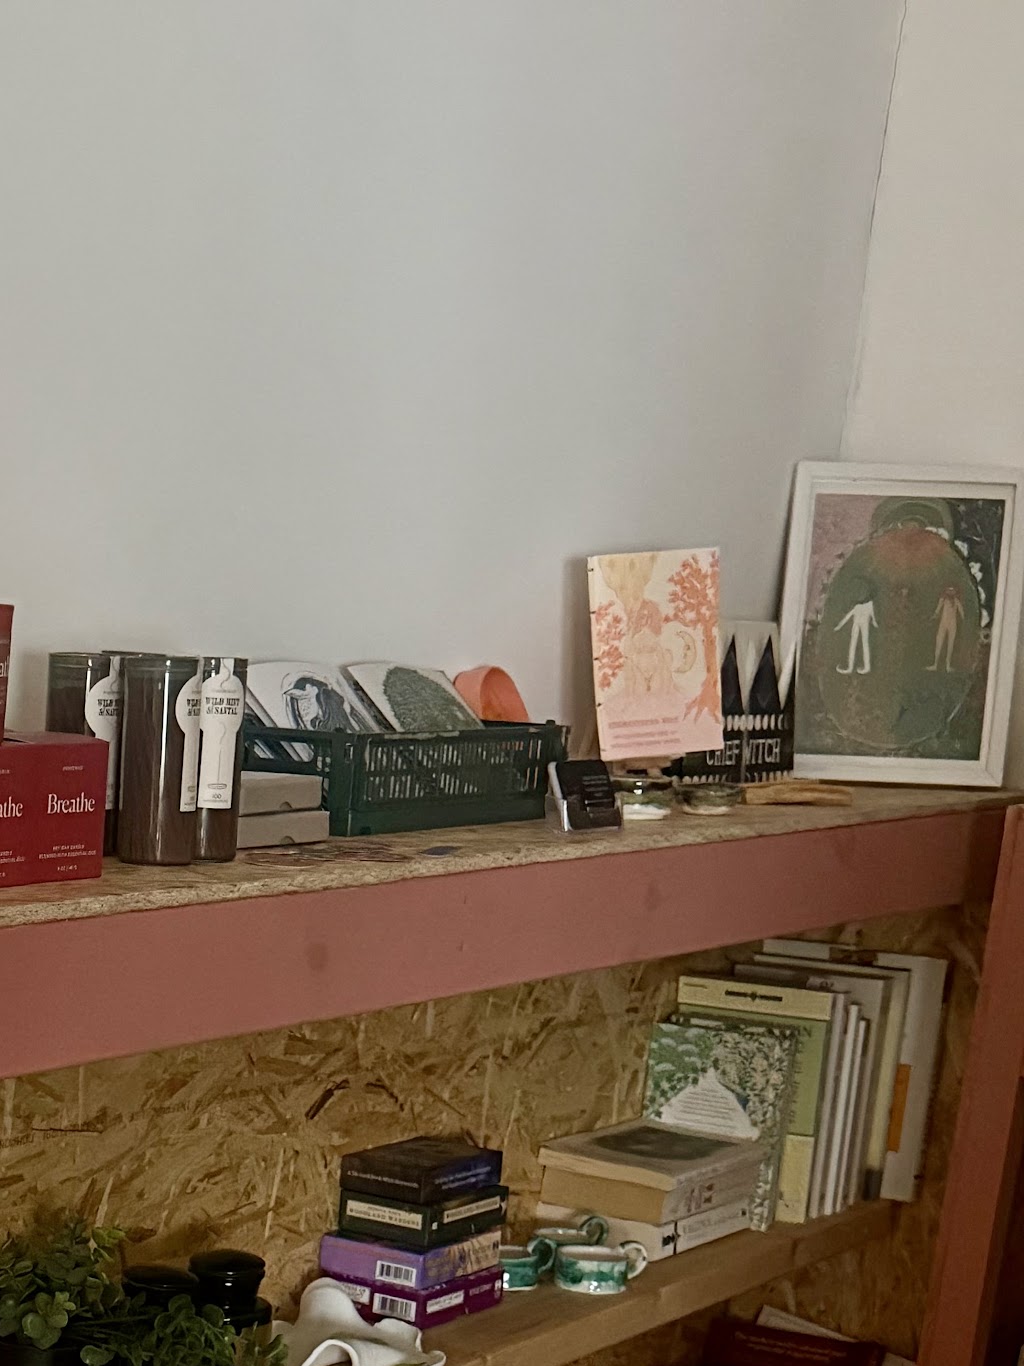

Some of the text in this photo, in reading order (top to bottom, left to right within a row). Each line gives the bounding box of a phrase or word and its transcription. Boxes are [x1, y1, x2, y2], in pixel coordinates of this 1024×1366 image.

[205, 697, 224, 708] WILD
[214, 706, 238, 716] SANTAL
[743, 738, 781, 765] WITCH
[46, 792, 96, 815] Breathe
